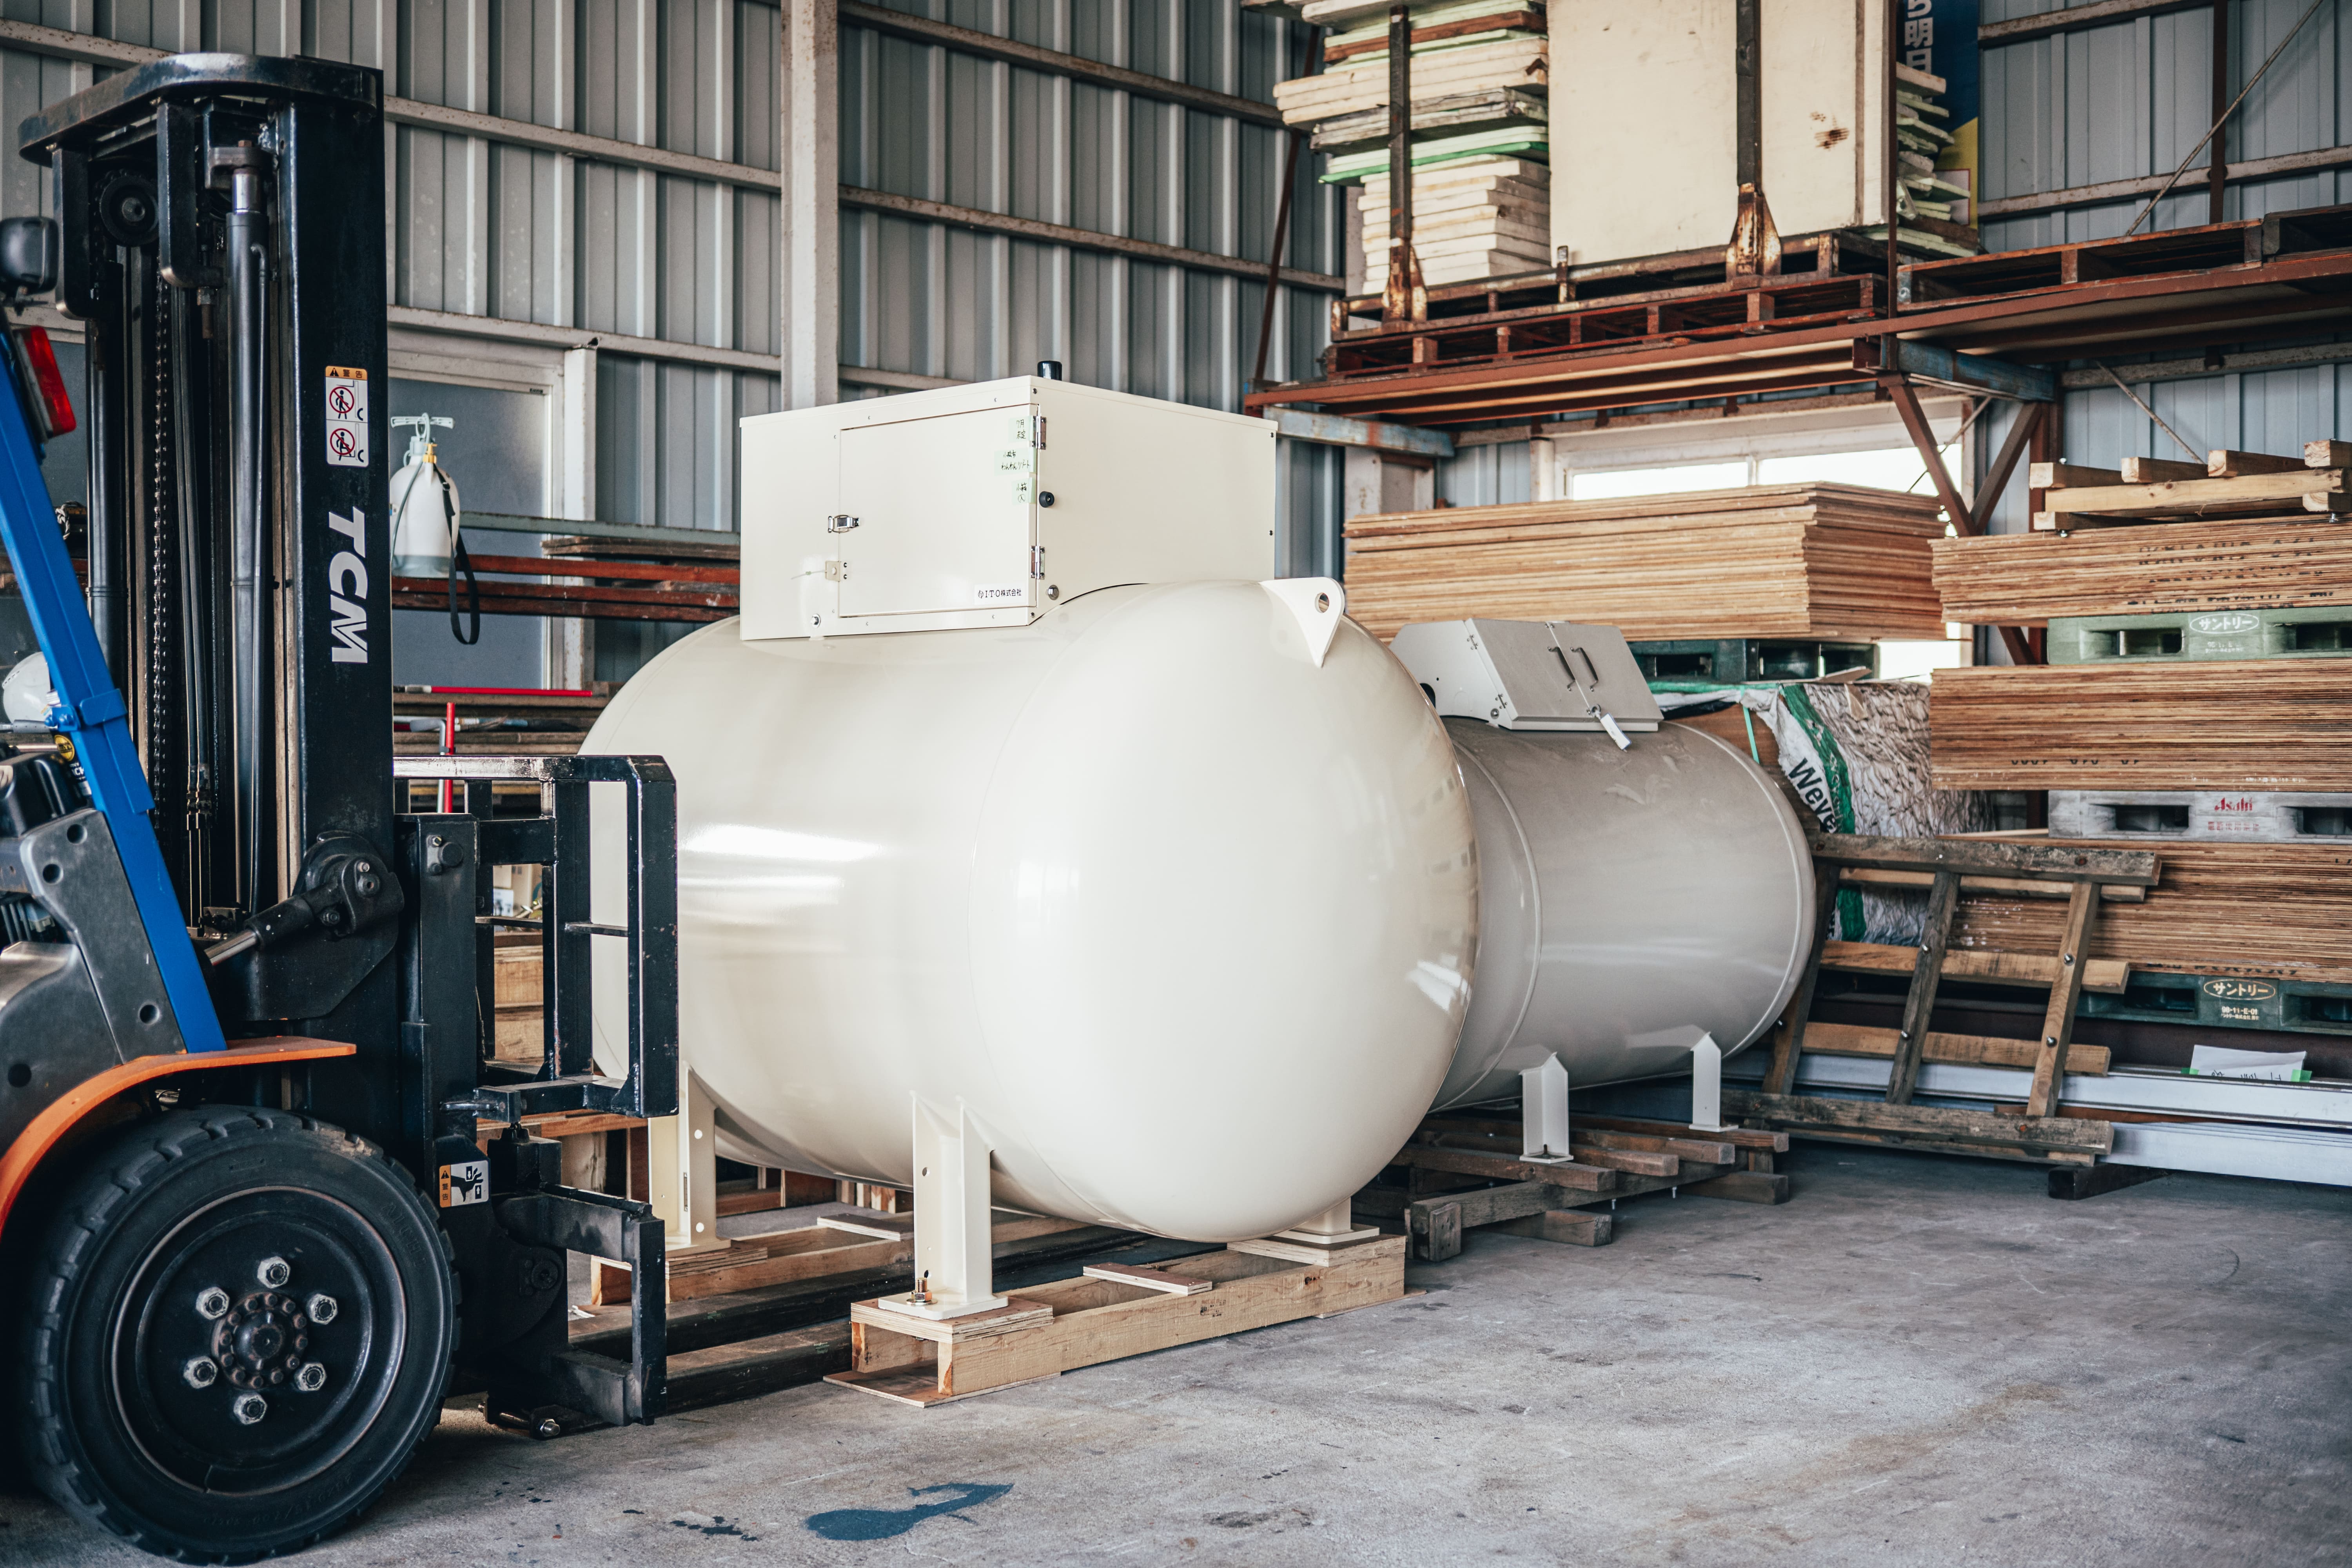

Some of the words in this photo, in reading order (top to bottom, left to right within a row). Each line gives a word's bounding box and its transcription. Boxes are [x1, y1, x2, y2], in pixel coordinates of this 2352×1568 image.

[343, 369, 363, 378] 警告
[1016, 430, 1026, 439] 未定
[328, 506, 368, 663] TCM
[2199, 616, 2252, 631] サントリー
[2214, 797, 2252, 812] Asahi
[2213, 982, 2268, 996] サントリー
[442, 1183, 448, 1200] 警告
